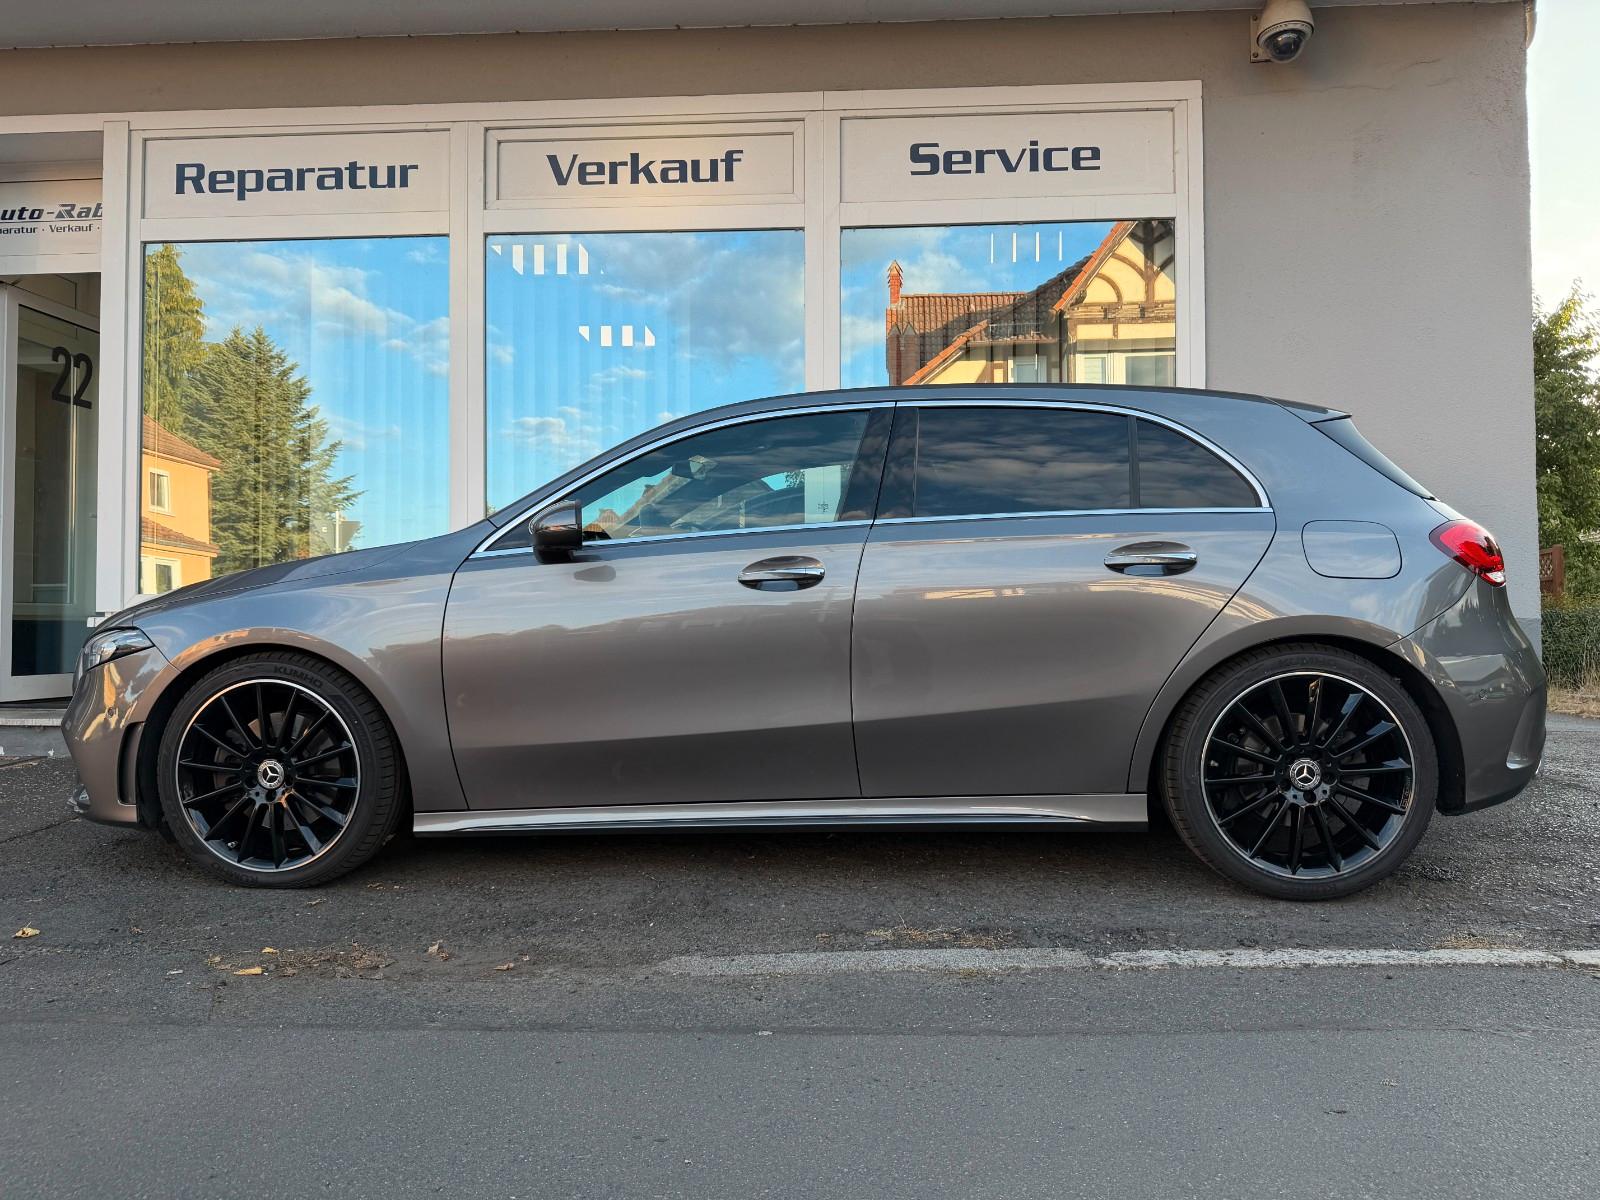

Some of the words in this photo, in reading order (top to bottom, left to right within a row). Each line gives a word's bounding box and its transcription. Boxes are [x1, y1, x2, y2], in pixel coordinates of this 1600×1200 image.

[546, 150, 743, 186] Verkauf
[909, 140, 1100, 175] Service
[175, 161, 419, 201] Reparatur
[49, 223, 93, 233] Verkauf
[52, 347, 93, 409] 22
[273, 665, 323, 689] KUMHO
